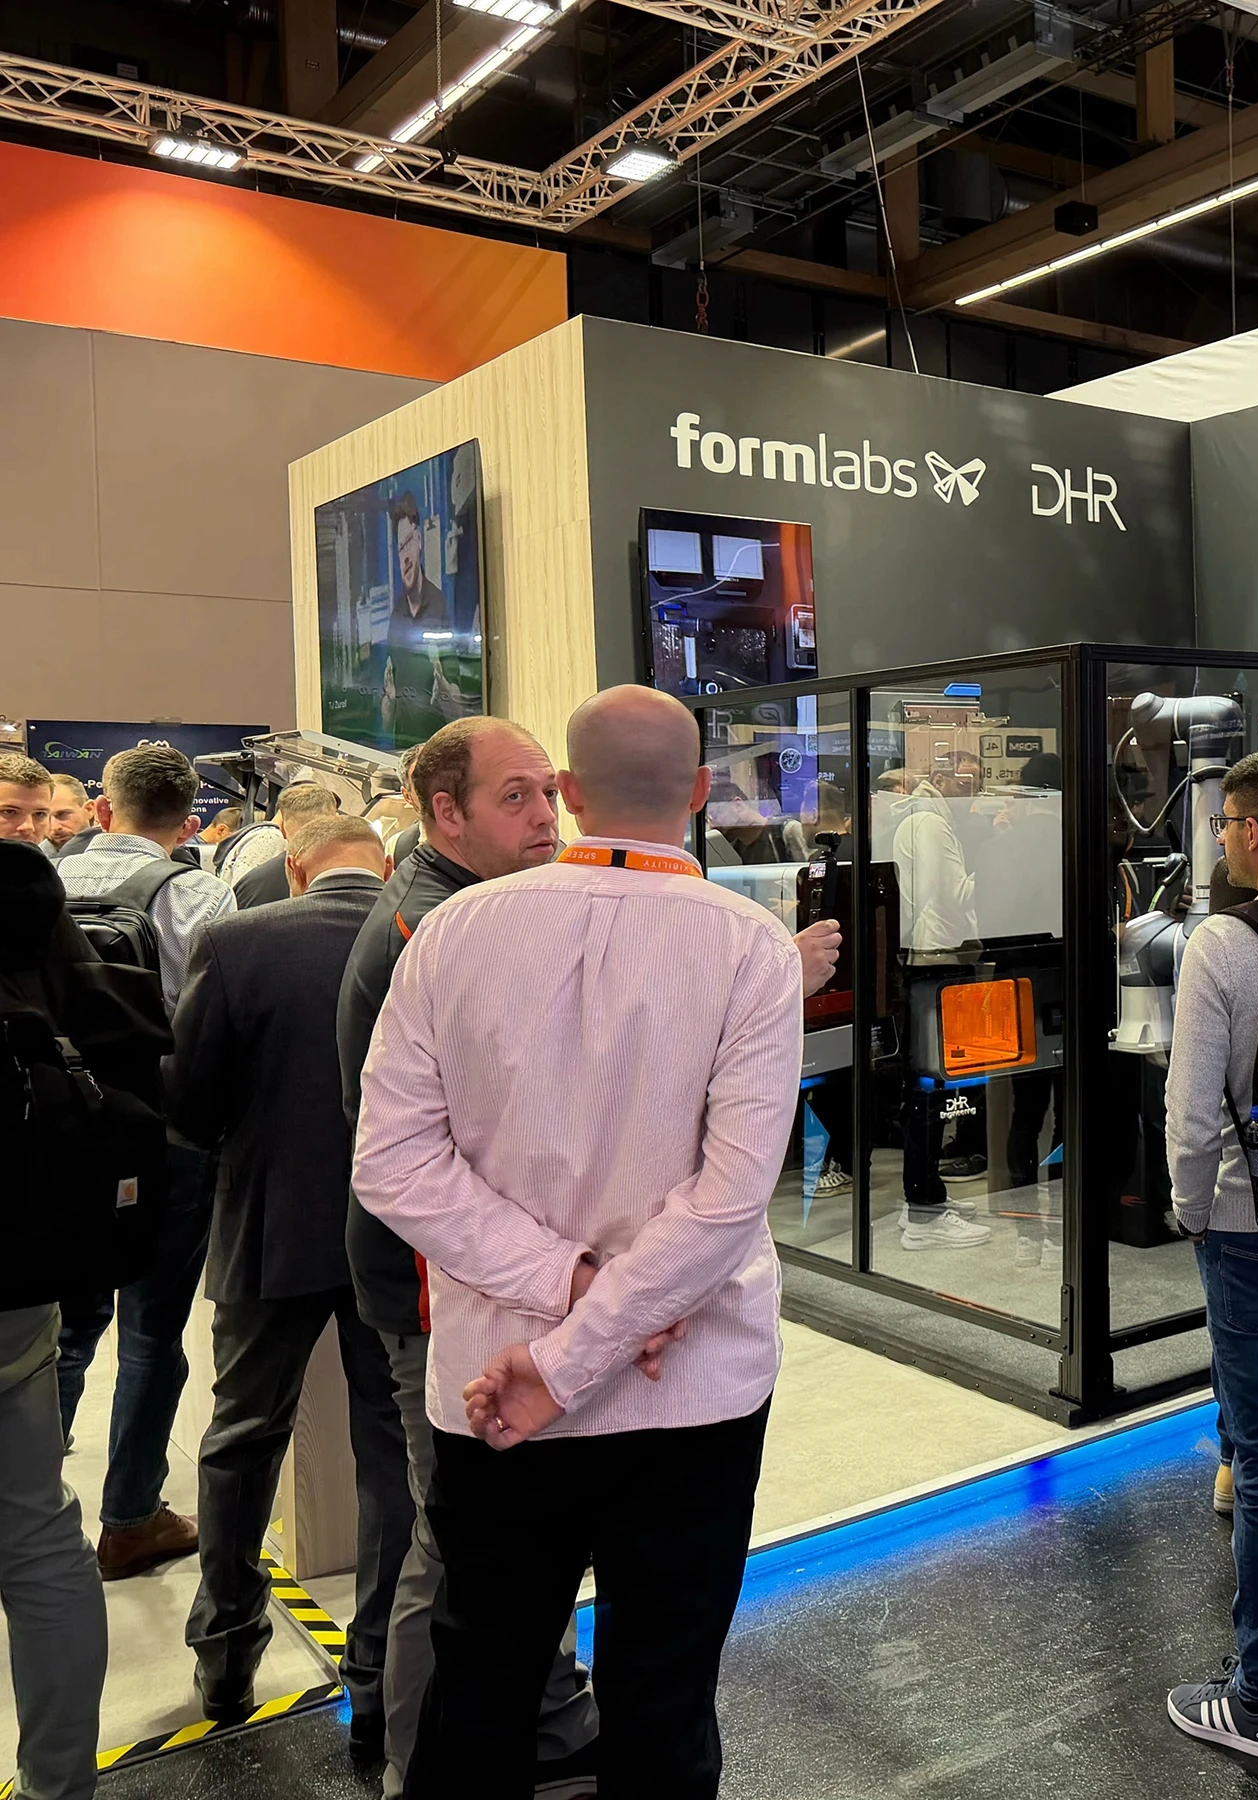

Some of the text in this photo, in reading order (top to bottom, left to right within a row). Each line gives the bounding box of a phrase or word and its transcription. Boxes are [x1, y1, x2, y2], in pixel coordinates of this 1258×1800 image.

[669, 412, 919, 499] formlabs
[1030, 463, 1128, 532] DHR
[41, 746, 103, 759] TAIWAN
[566, 850, 597, 860] SPEED
